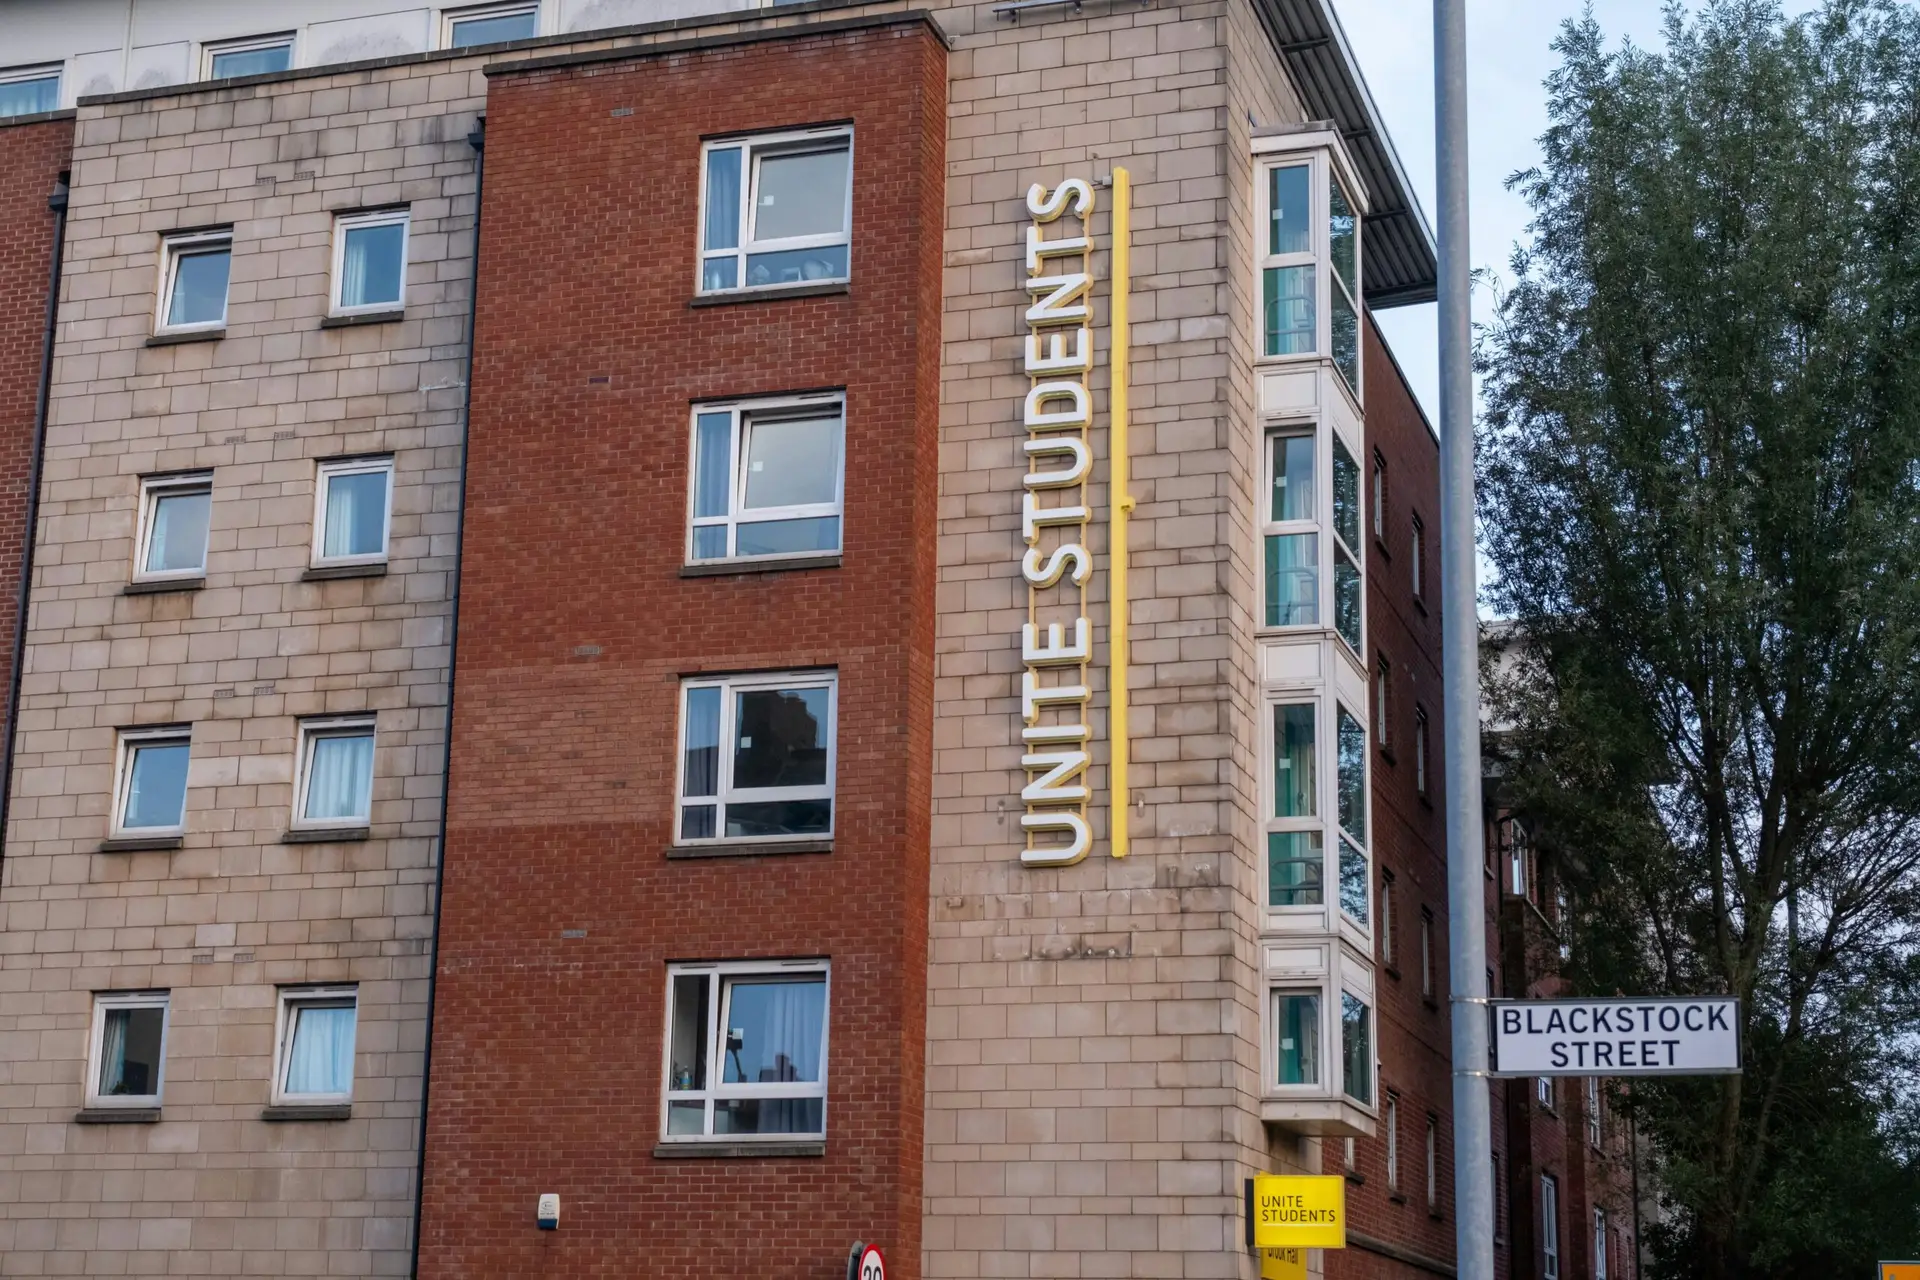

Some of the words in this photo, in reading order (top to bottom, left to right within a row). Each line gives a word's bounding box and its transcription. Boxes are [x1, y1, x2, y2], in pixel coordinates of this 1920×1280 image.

[1022, 178, 1095, 588] STUDENTS
[1021, 617, 1092, 867] UNITE
[1503, 1005, 1729, 1034] BLACKSTOCK
[1550, 1040, 1681, 1068] STREET
[1261, 1195, 1303, 1208] UNITE
[1262, 1209, 1336, 1222] STUDENTS
